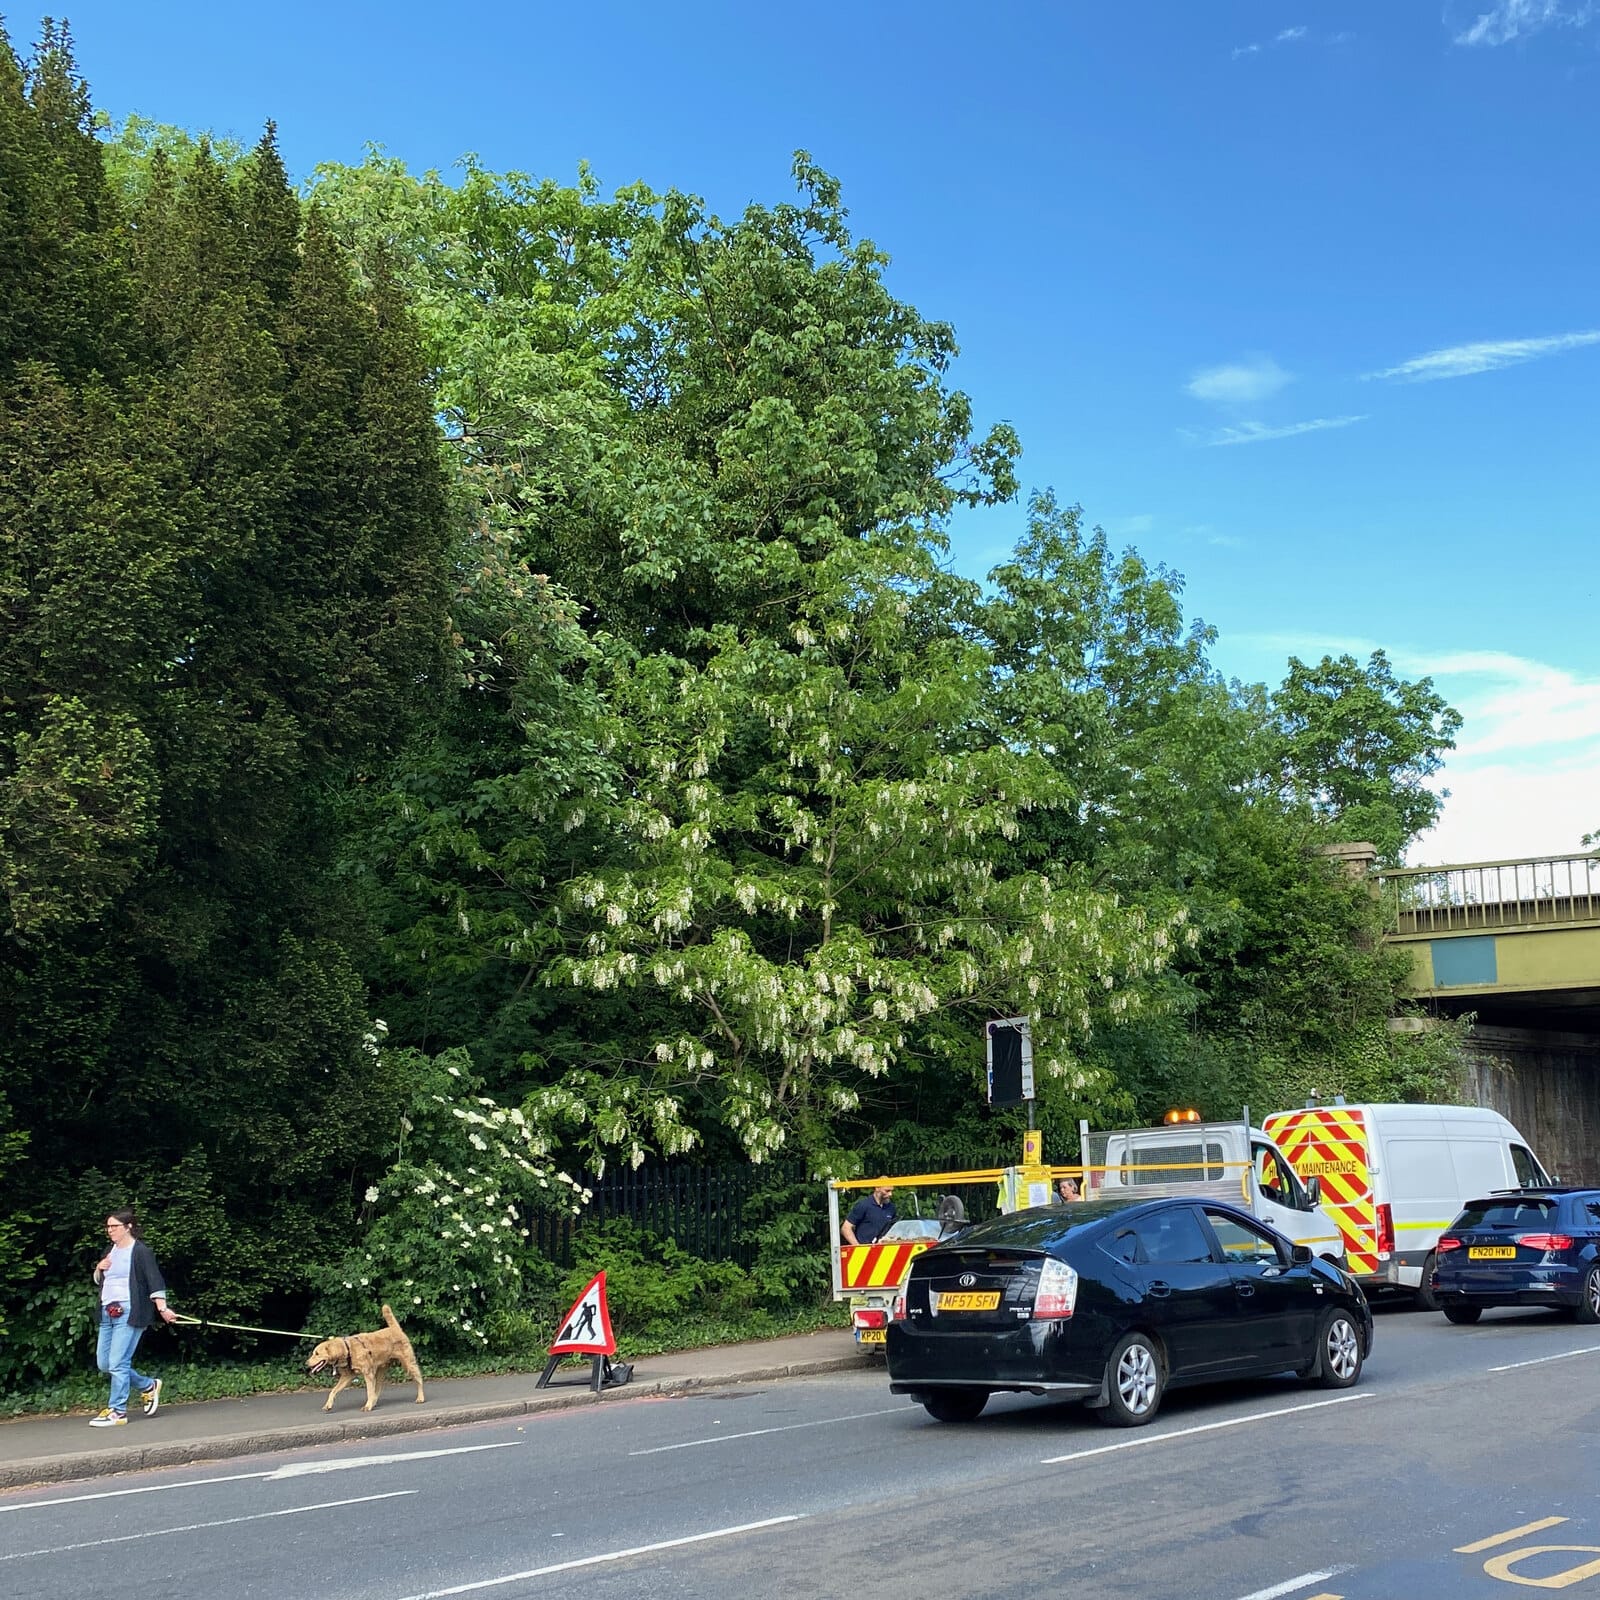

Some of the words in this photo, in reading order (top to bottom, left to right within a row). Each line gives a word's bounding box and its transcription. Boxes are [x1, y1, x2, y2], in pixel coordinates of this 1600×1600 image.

[1302, 1160, 1357, 1175] MAINTENANCE
[1472, 1247, 1494, 1257] FN20
[1495, 1247, 1512, 1257] HWU
[943, 1294, 973, 1308] MF57
[975, 1294, 998, 1308] SFN
[861, 1330, 882, 1342] KP20
